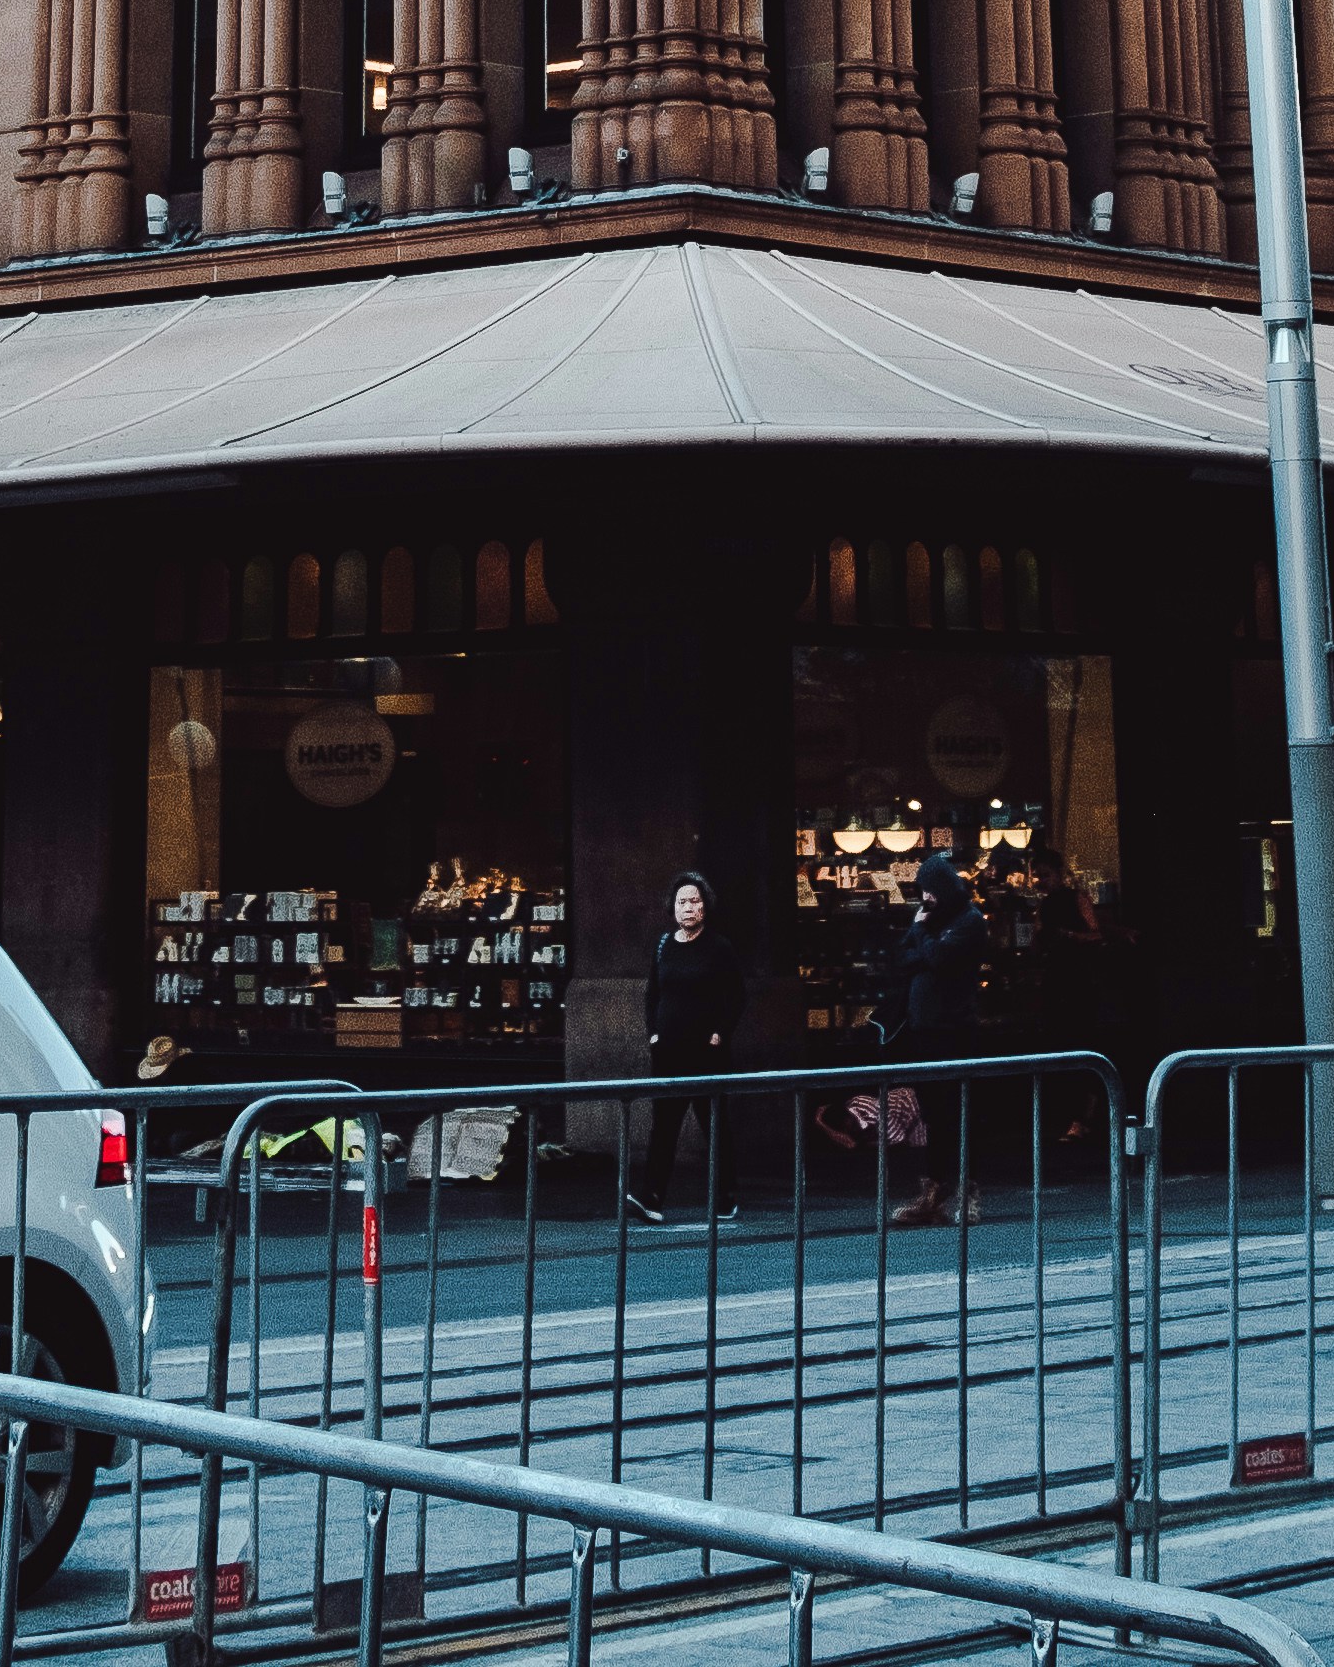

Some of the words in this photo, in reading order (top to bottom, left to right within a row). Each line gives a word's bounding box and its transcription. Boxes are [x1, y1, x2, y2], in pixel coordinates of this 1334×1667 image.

[298, 742, 382, 765] HAIGH'S
[150, 1574, 197, 1602] coat
[216, 1569, 241, 1593] ire
